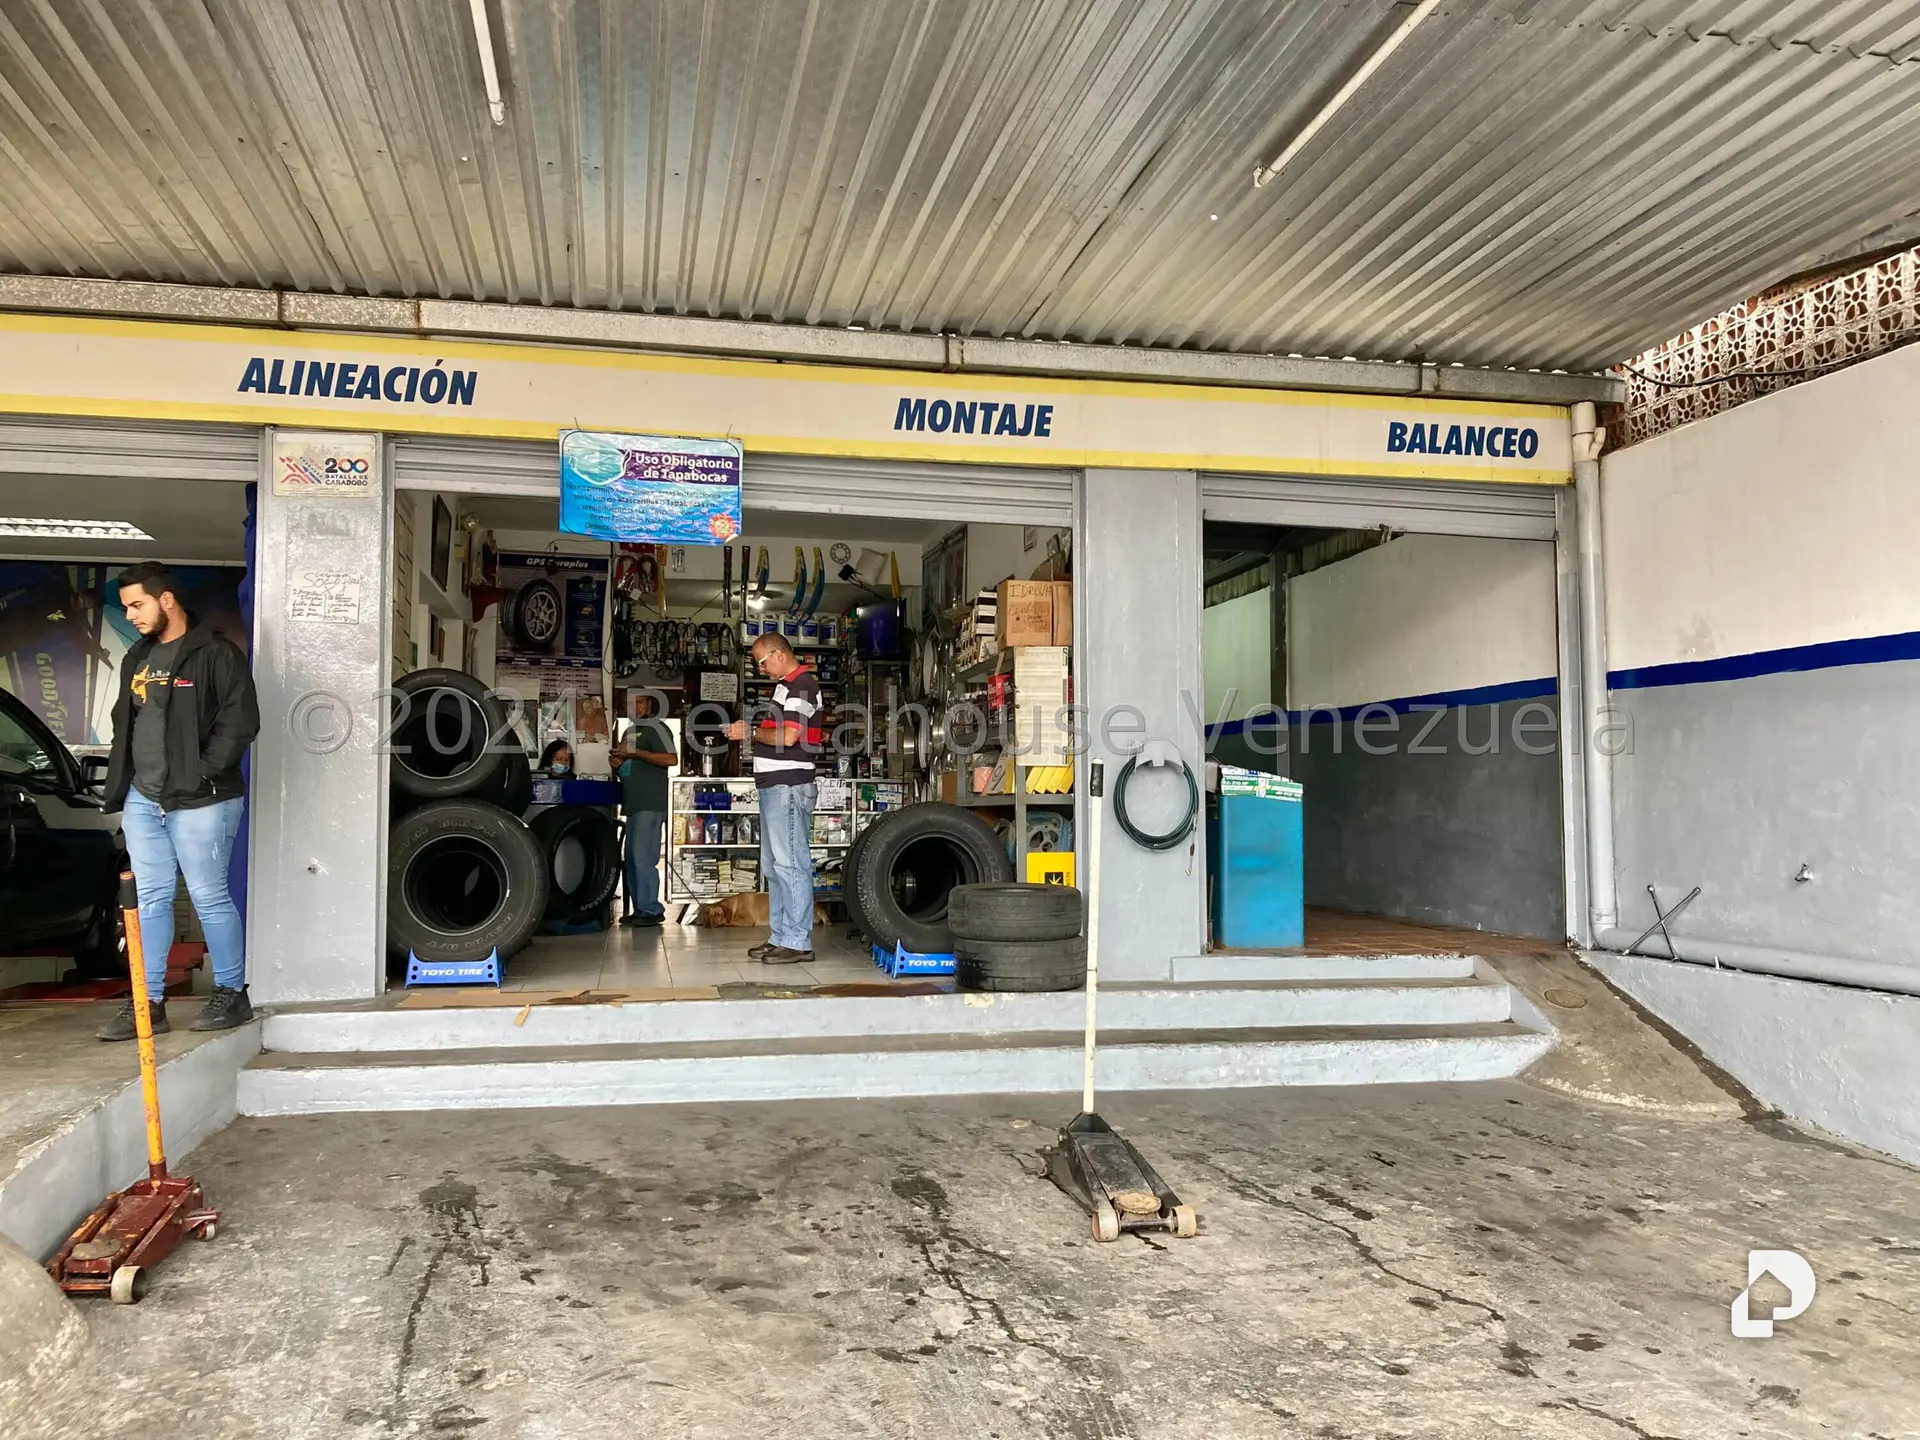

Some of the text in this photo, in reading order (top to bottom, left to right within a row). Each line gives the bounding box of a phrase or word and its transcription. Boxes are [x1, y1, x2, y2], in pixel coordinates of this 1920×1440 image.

[237, 357, 478, 406] ALINEACIÓN
[894, 397, 1054, 437] MONTAJE
[1386, 421, 1539, 459] BALANCEO
[325, 457, 370, 474] 200
[635, 453, 733, 470] Uso Obligatorio
[325, 479, 369, 487] CARABOBO
[643, 467, 728, 483] de Tapabocas
[526, 557, 546, 565] GPS
[36, 652, 67, 744] GOODYEA
[908, 959, 938, 967] TOYO
[421, 968, 484, 977] TOYO TIRE
